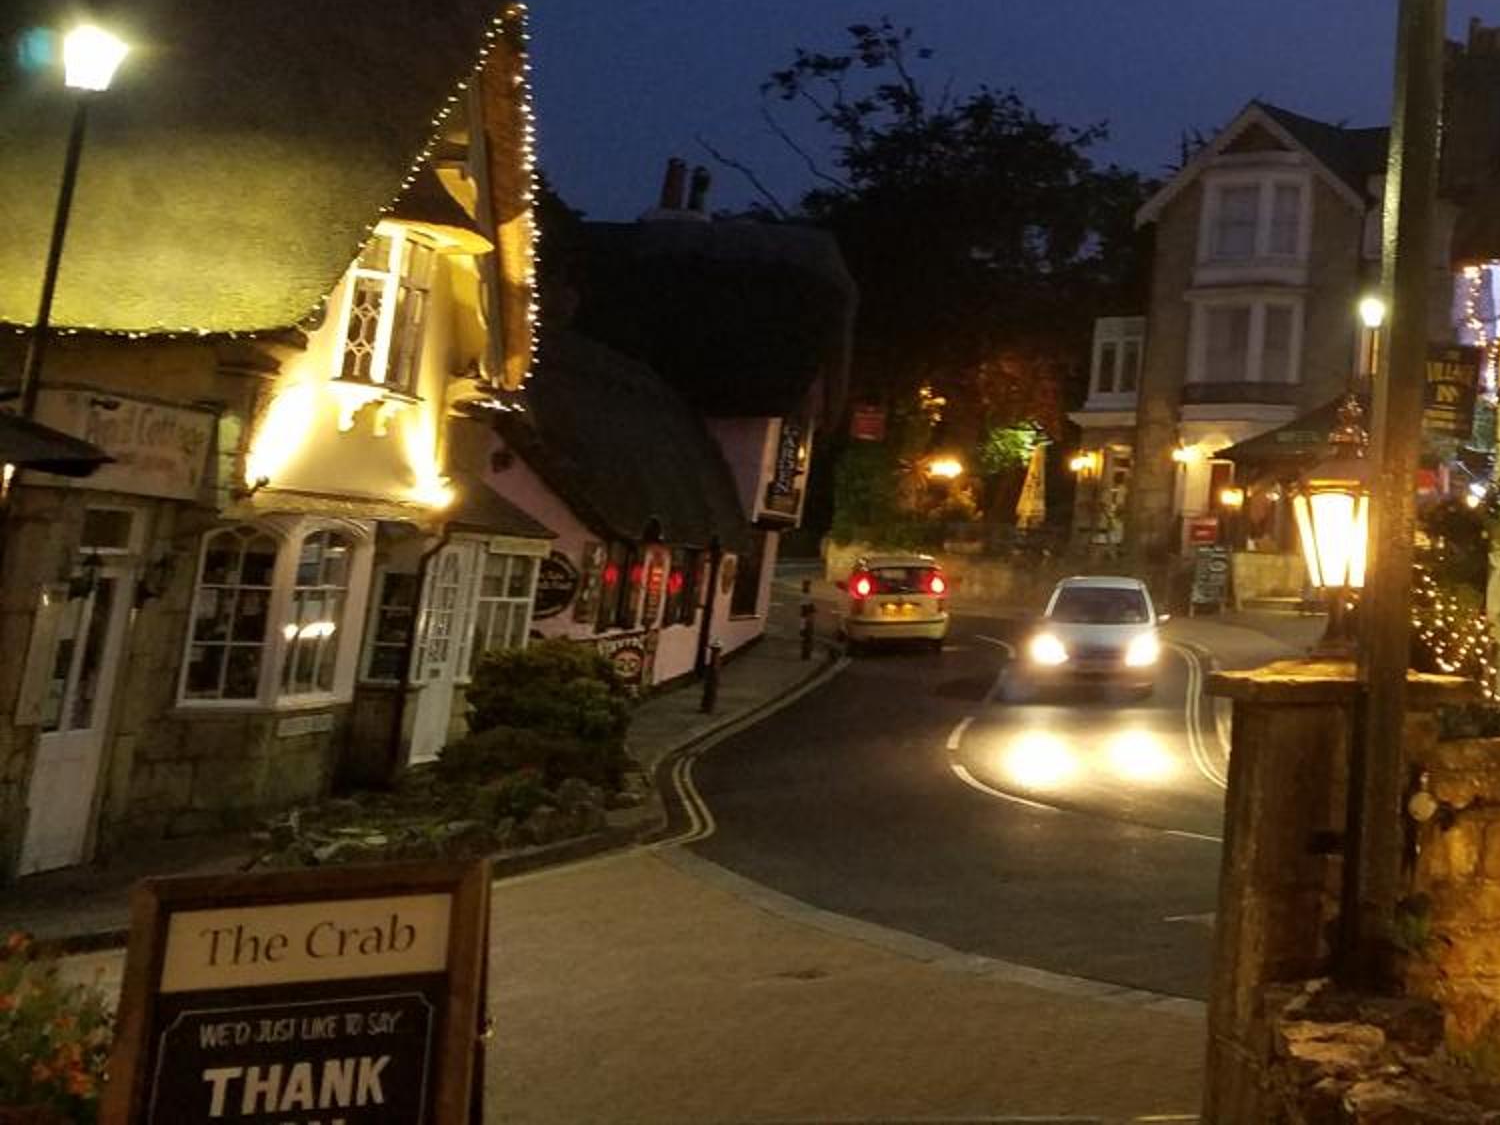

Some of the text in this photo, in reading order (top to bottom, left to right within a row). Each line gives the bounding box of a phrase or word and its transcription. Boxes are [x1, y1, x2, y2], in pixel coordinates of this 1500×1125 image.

[200, 914, 417, 967] The Crab
[256, 1017, 294, 1044] JUST
[302, 1015, 337, 1039] LIKE
[203, 1055, 391, 1118] THANK
